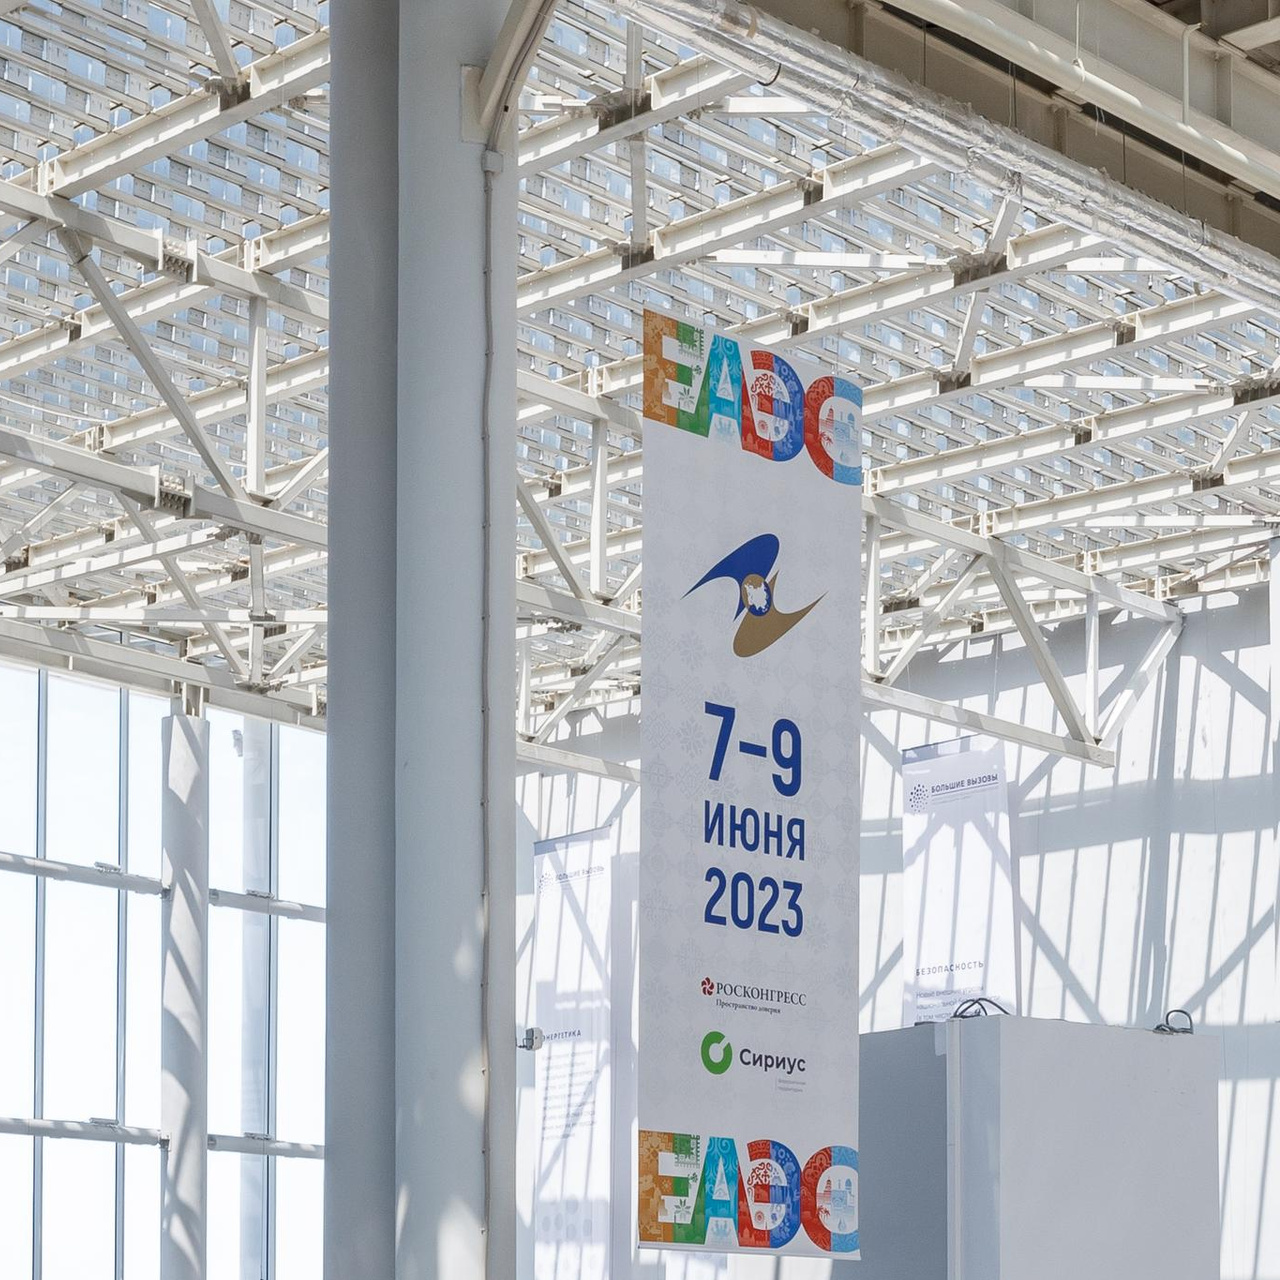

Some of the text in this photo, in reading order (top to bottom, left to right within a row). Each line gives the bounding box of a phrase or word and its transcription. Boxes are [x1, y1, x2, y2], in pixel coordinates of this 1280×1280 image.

[643, 309, 862, 486] ЕАЭС
[931, 773, 998, 793] БОЛЬШИЕ ВЫЗОВЫ
[704, 800, 805, 861] ИЮНЯ
[704, 867, 804, 938] 2023
[915, 961, 985, 976] БЕЗОПАСНОСТЬ
[716, 982, 807, 1006] РОСКОНГРЕСС
[739, 1048, 806, 1075] Сириус
[638, 1129, 859, 1253] ЕАЭС
